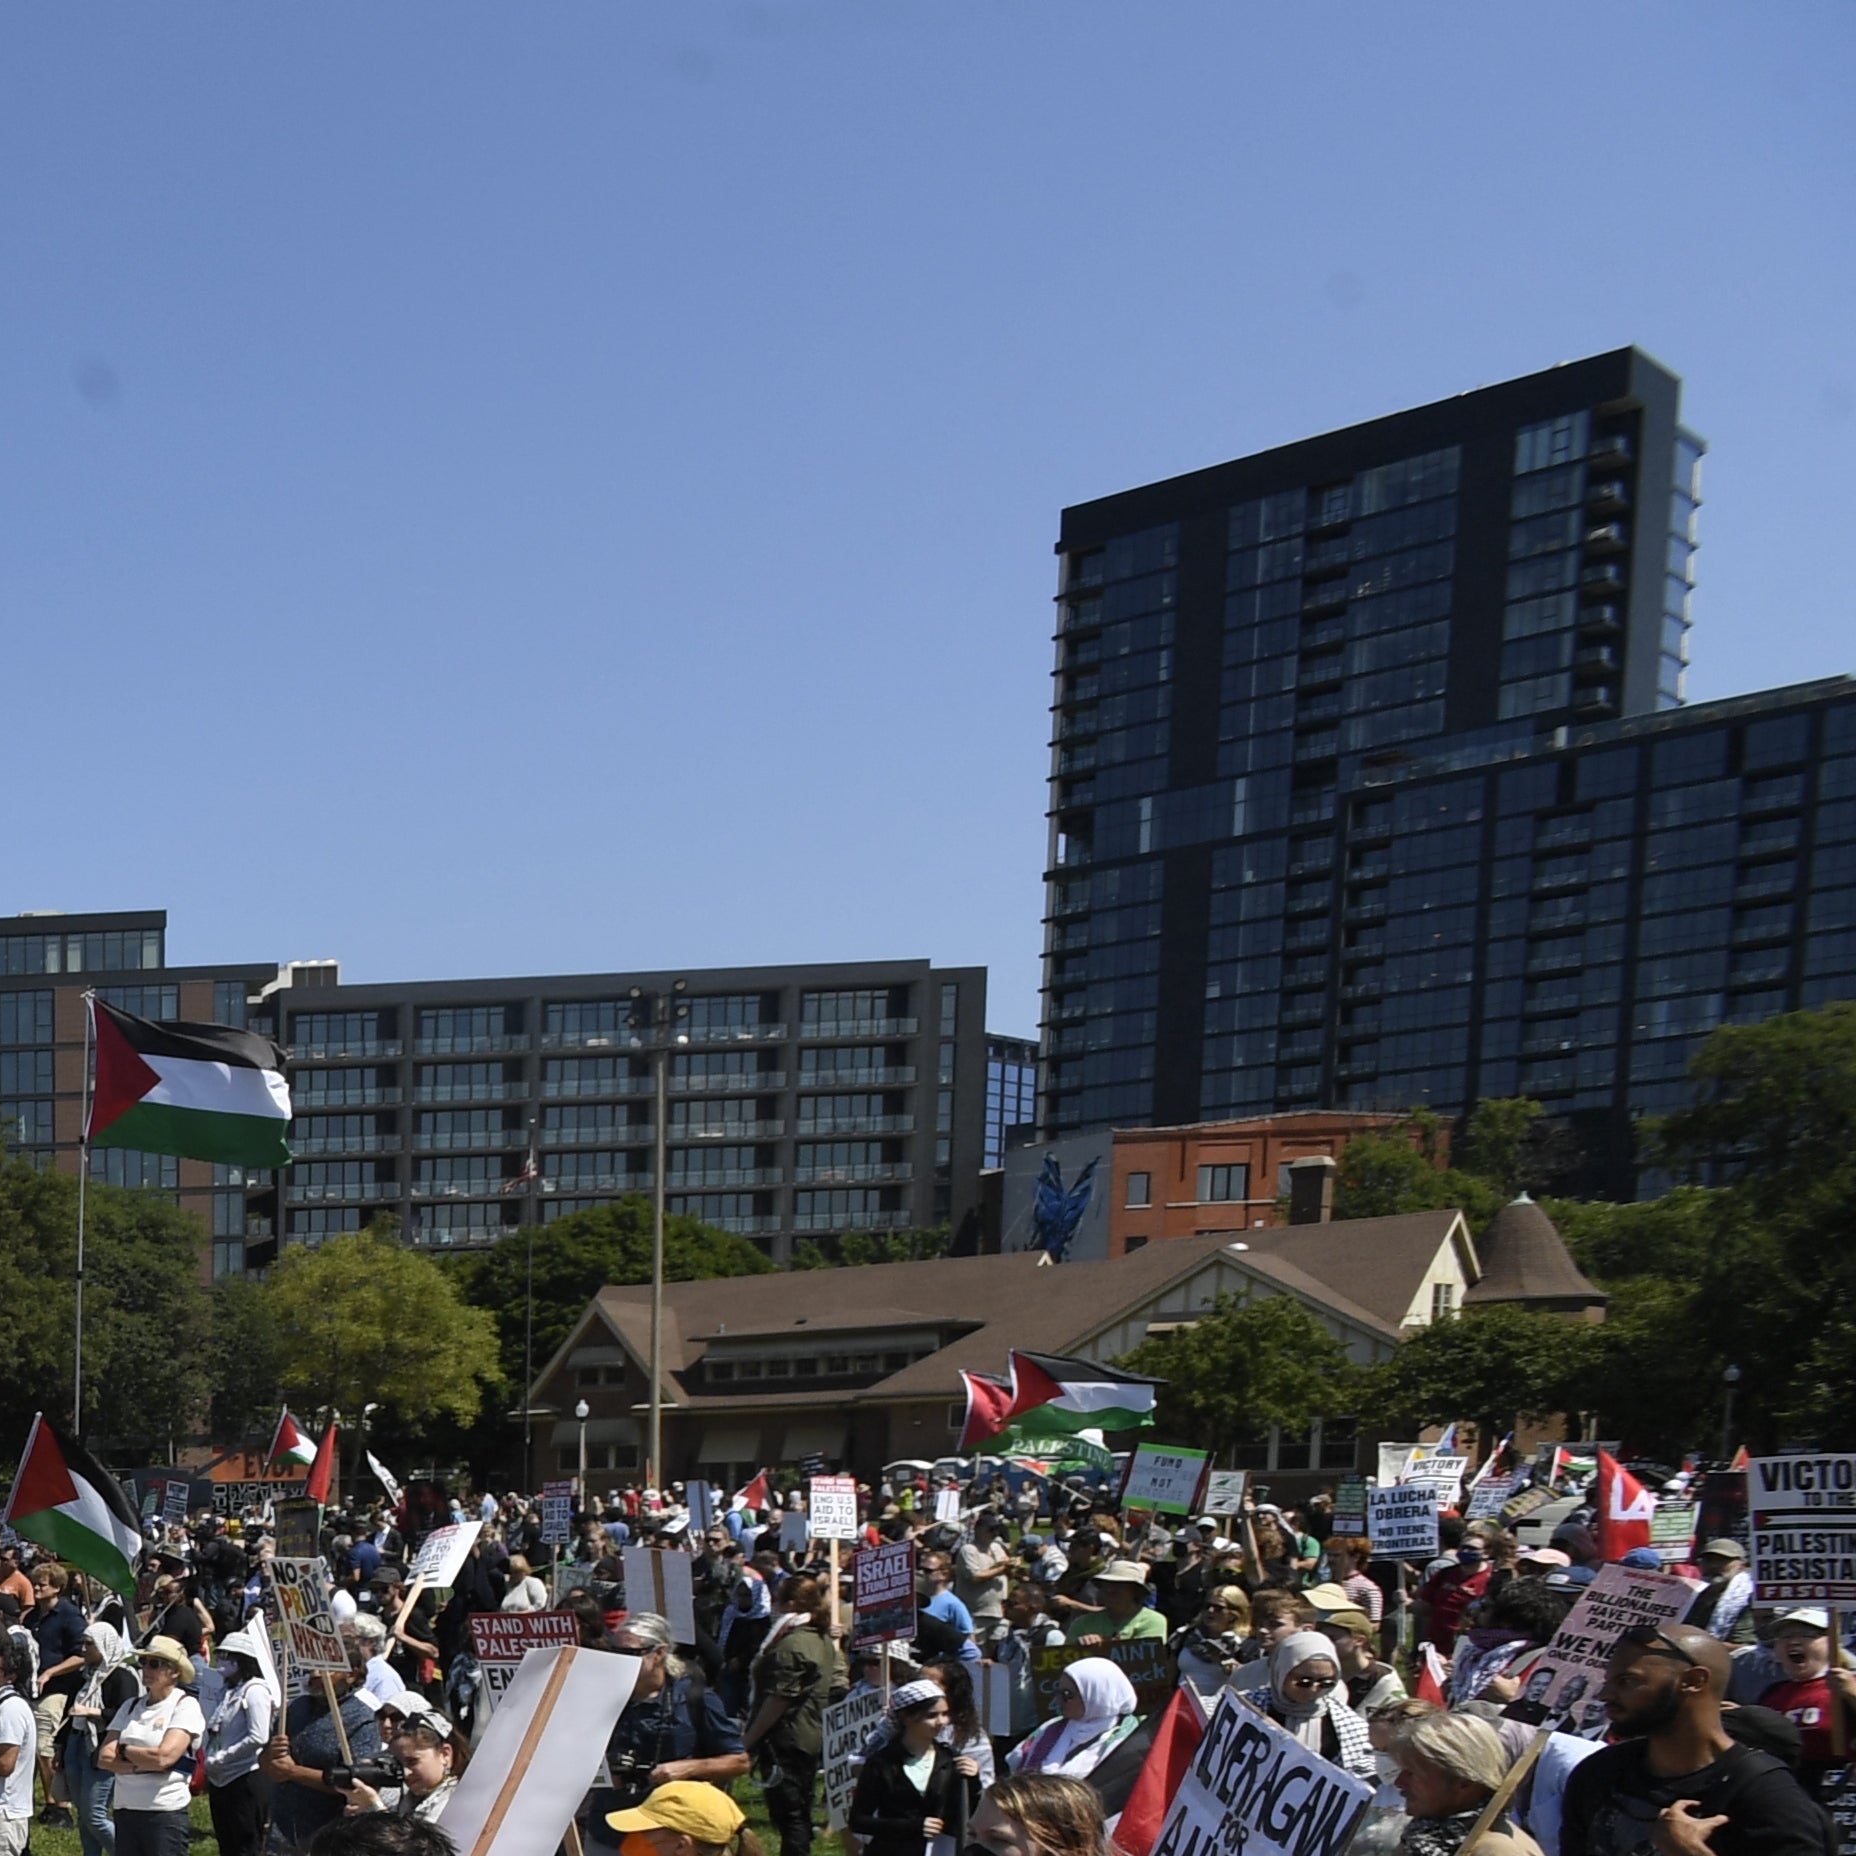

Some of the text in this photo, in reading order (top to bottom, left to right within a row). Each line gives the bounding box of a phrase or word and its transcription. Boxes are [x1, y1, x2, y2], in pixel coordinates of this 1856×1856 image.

[1011, 1437, 1111, 1470] PALESTINE
[1412, 1459, 1463, 1471] VICTORY
[1759, 1460, 1856, 1491] VICTO
[814, 1496, 852, 1504] END U.S
[1371, 1489, 1436, 1506] LA LUCHA
[814, 1506, 853, 1515] AID TO
[1375, 1506, 1430, 1521] OBRERA
[814, 1517, 853, 1526] ISRAEL!
[1378, 1524, 1426, 1537] NO TIENE
[1372, 1537, 1433, 1550] FRONTERAS
[271, 1561, 297, 1585] NO
[1627, 1585, 1656, 1600] THE
[1585, 1591, 1679, 1618] BILLIONAIRES
[1587, 1605, 1661, 1627] HAVE TWO
[471, 1616, 574, 1635] STAND WITH
[1555, 1631, 1588, 1652] WE
[1548, 1649, 1583, 1664] ONE OF
